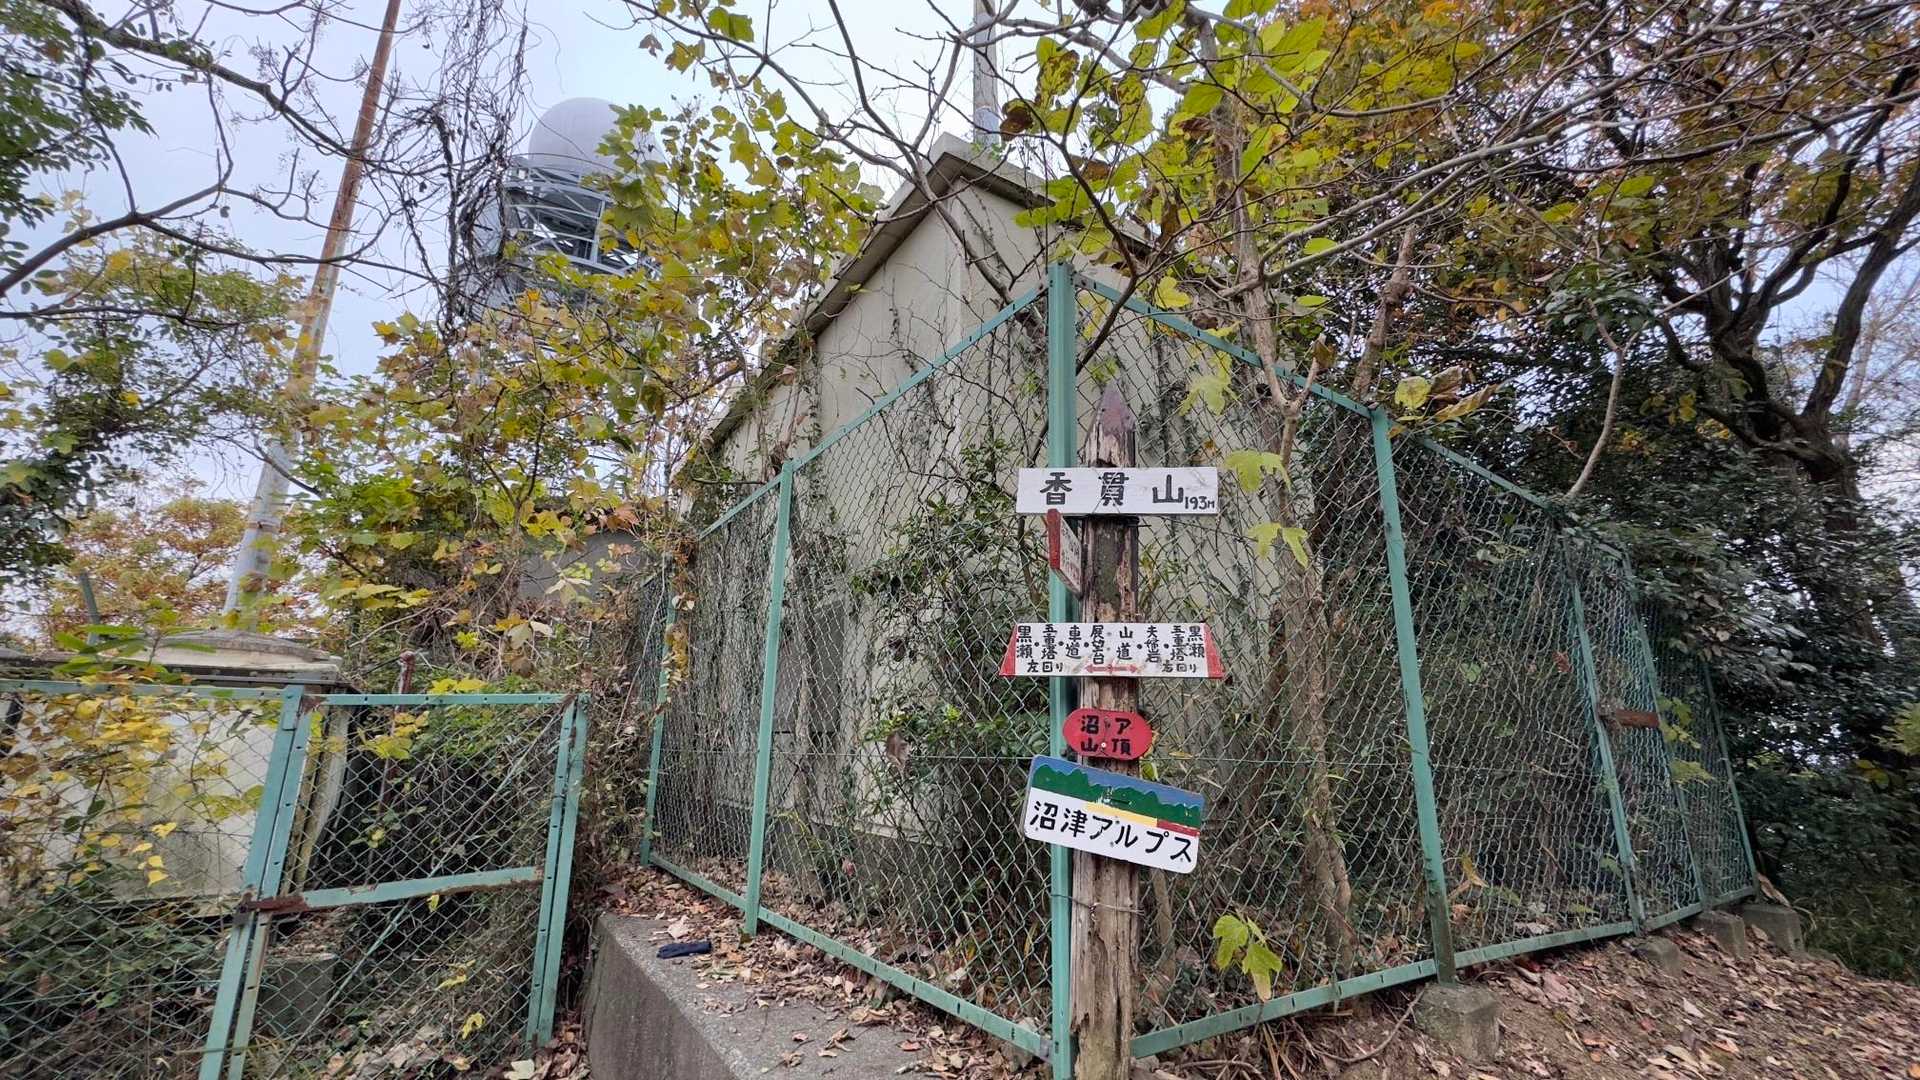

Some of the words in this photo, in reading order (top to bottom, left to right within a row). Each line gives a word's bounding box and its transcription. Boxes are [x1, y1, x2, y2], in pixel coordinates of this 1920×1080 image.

[1040, 472, 1183, 506] 香貫山
[1016, 625, 1033, 658] 黒瀬
[1041, 624, 1058, 660] 五重塔
[1065, 625, 1082, 659] 車道
[1090, 624, 1105, 665] 展望台
[1116, 626, 1133, 660] 山道
[1170, 625, 1188, 661] 五重塔
[1188, 625, 1205, 658] 黒瀬
[1027, 659, 1064, 673] 左回り
[1080, 737, 1131, 756] 山頂
[1029, 800, 1193, 863] 沼津アルプス
